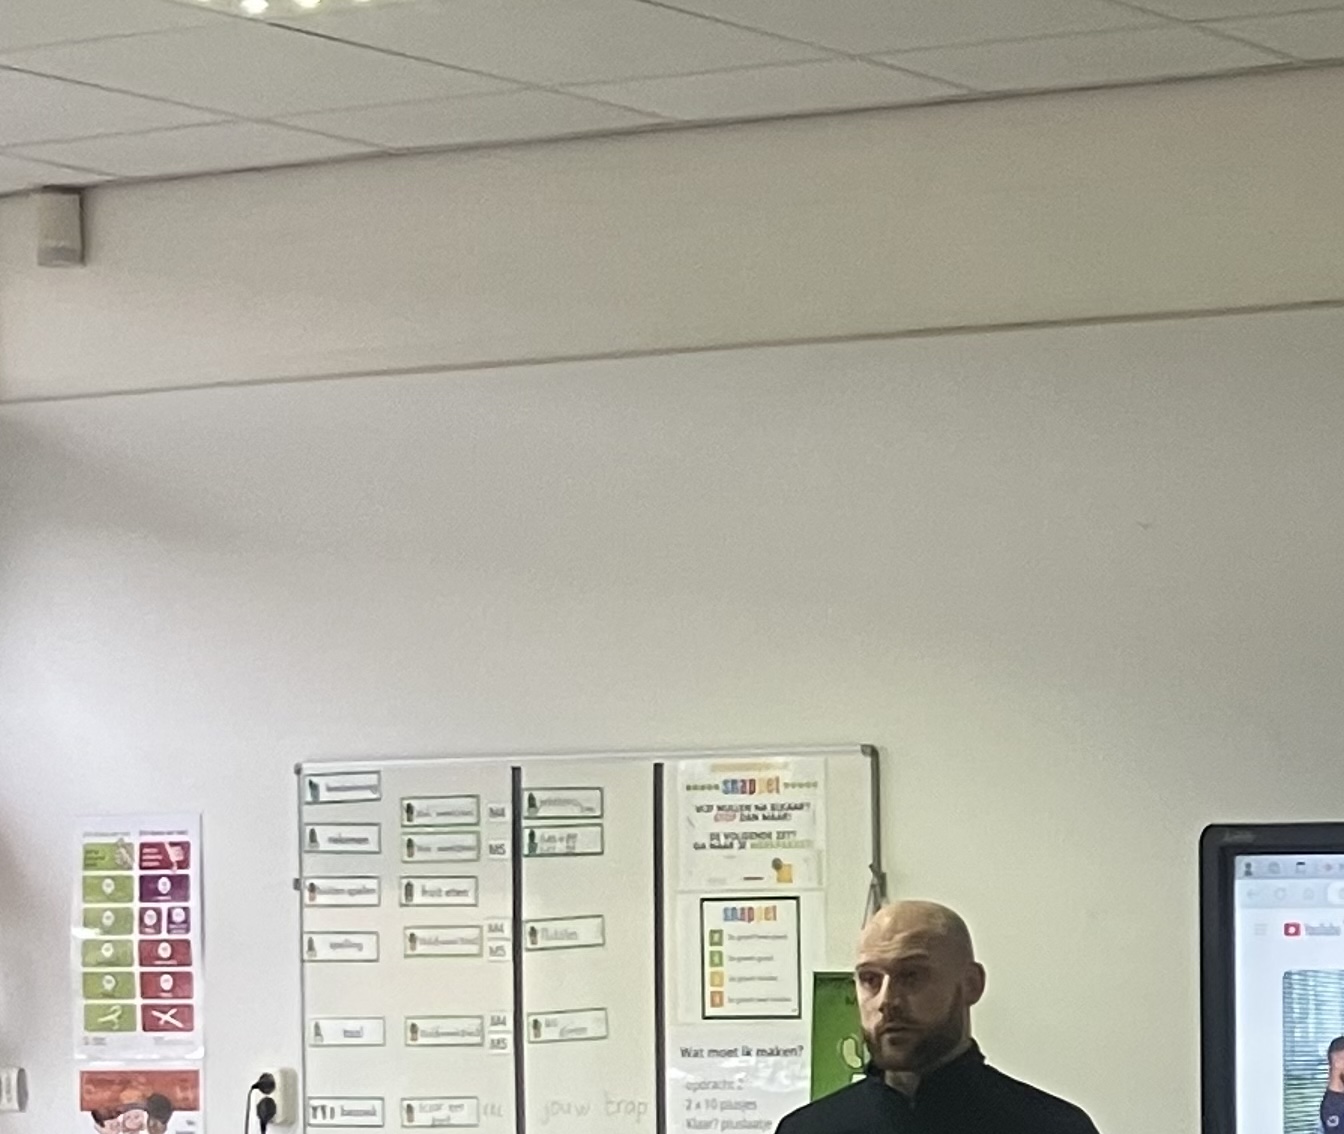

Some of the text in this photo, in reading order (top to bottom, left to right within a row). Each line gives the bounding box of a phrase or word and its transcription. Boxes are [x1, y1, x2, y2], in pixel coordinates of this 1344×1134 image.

[680, 1046, 704, 1058] Wat
[707, 1046, 738, 1058] moet
[756, 1045, 804, 1057] maken?
